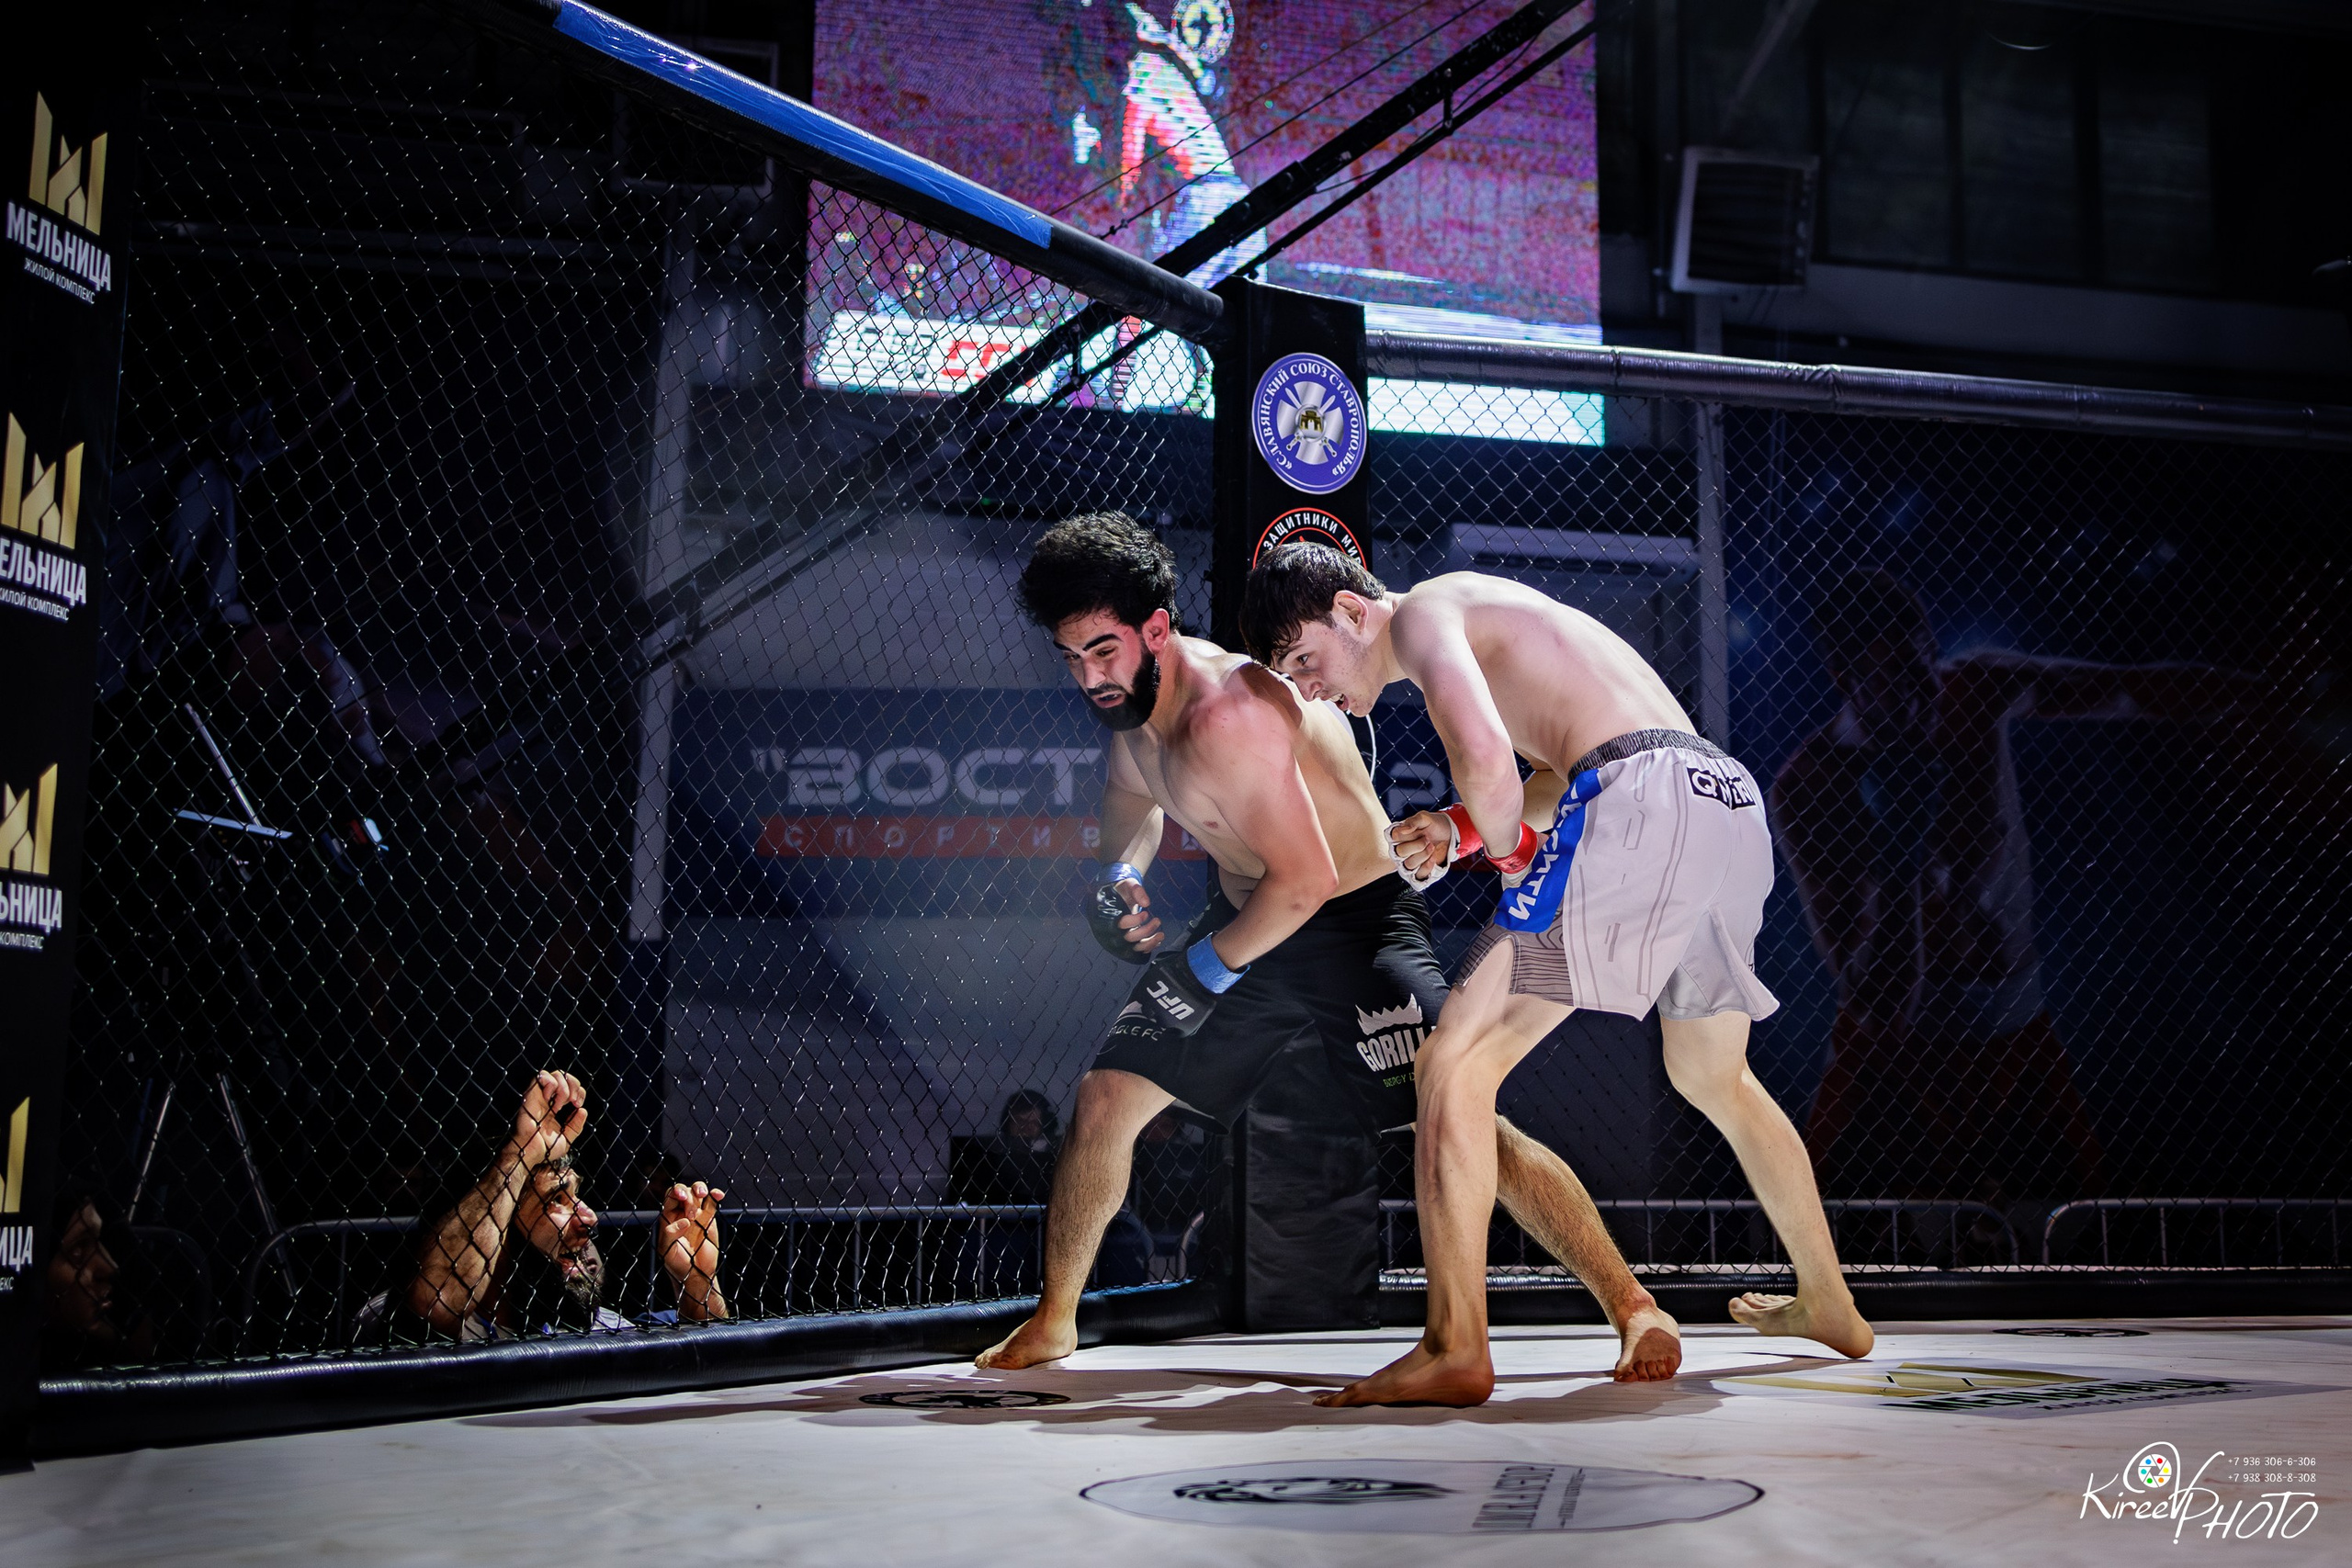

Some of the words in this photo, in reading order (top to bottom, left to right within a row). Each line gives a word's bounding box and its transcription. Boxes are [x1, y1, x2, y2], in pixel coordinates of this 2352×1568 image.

[6, 201, 111, 292] МЕЛЬНИЦА
[24, 257, 55, 284] ЖИЛОЙ
[55, 273, 96, 304] КОМПЛЕКС
[1290, 362, 1328, 378] СОЮЗ
[1262, 513, 1339, 551] ЗАЩИТНИКИ
[0, 537, 87, 607] ЕЛЬНИЦА
[0, 588, 27, 607] ИЛОЙ
[27, 595, 70, 621] КОМПЛЕКС
[750, 747, 1102, 806] "ВОСТ
[784, 826, 1102, 849] СПОРТИВ
[0, 881, 63, 933] ЬНИЦА
[1146, 980, 1195, 1021] UFC
